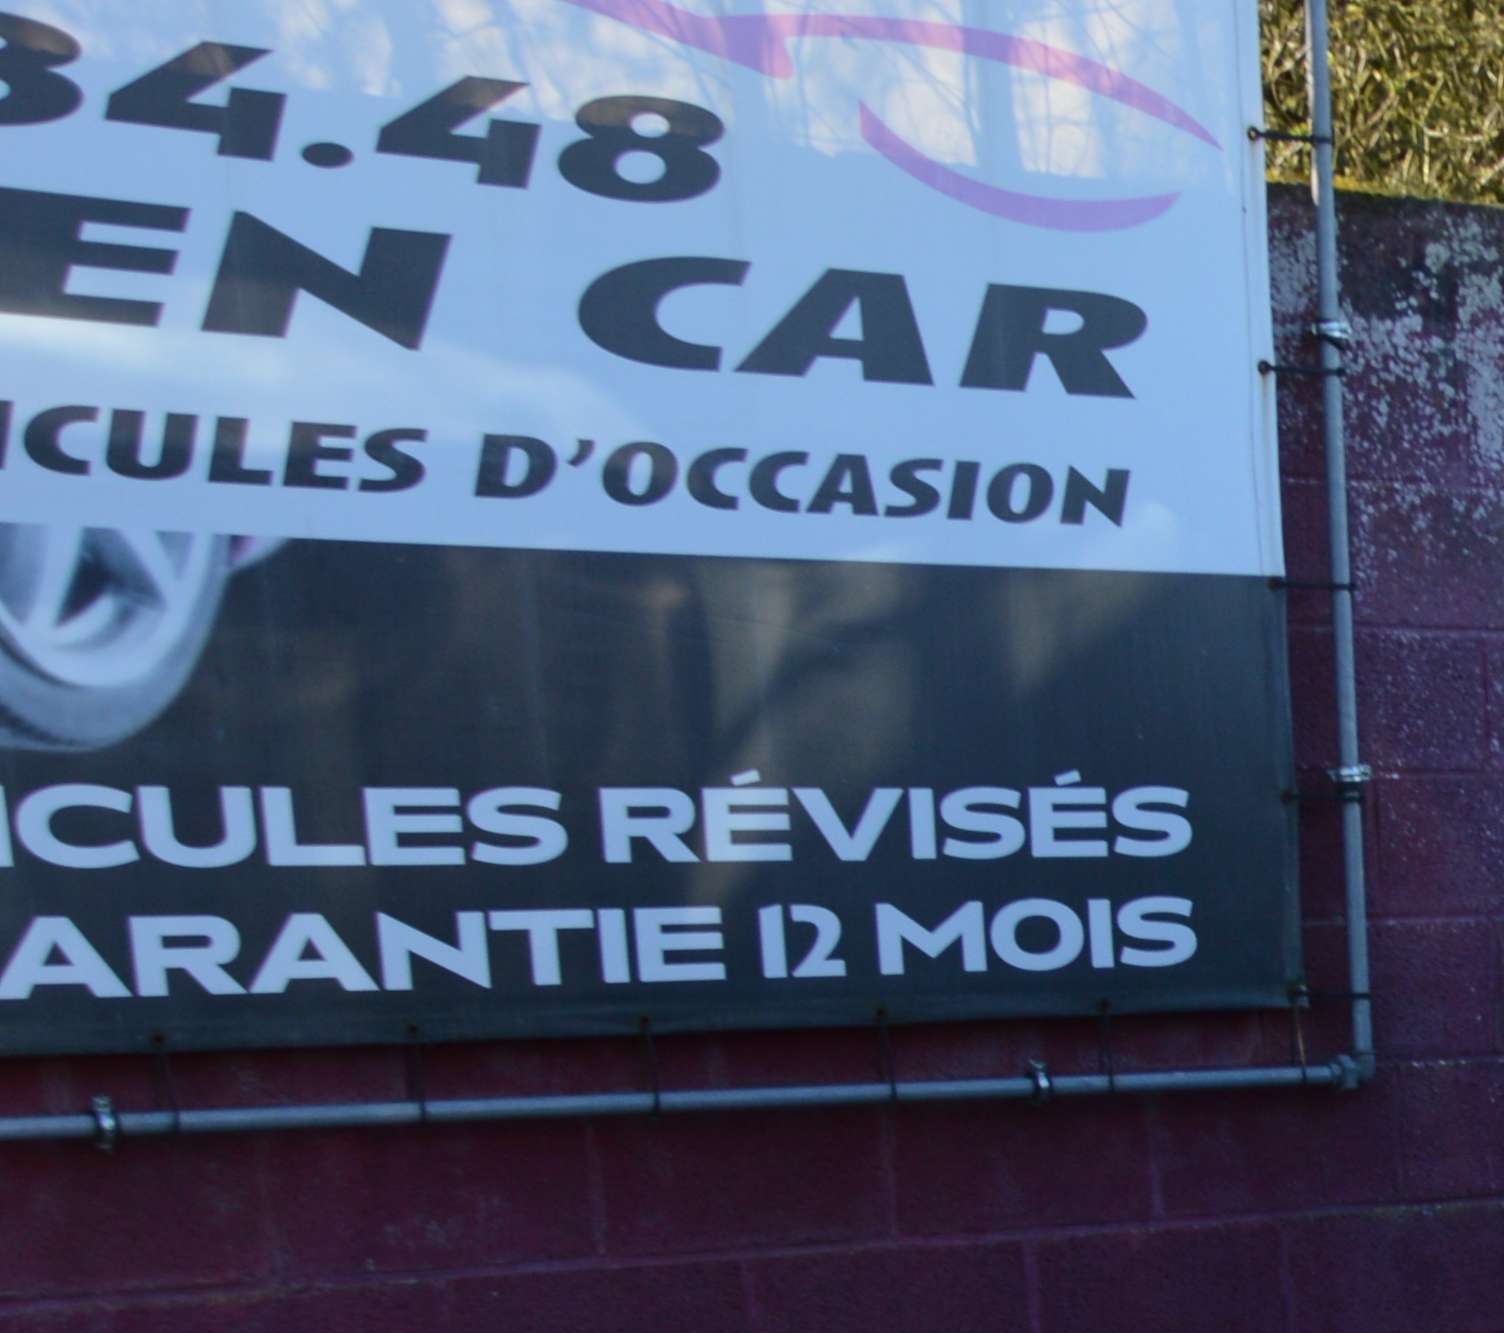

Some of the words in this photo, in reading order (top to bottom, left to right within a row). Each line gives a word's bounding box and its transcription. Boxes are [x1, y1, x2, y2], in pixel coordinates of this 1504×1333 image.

[578, 256, 1148, 399] CAR
[474, 433, 1130, 528] D'OCCASION
[598, 768, 1193, 863] RÉVISÉS
[0, 906, 726, 1000] ARANTIE
[757, 903, 847, 979] 12
[875, 896, 1198, 976] MOIS
